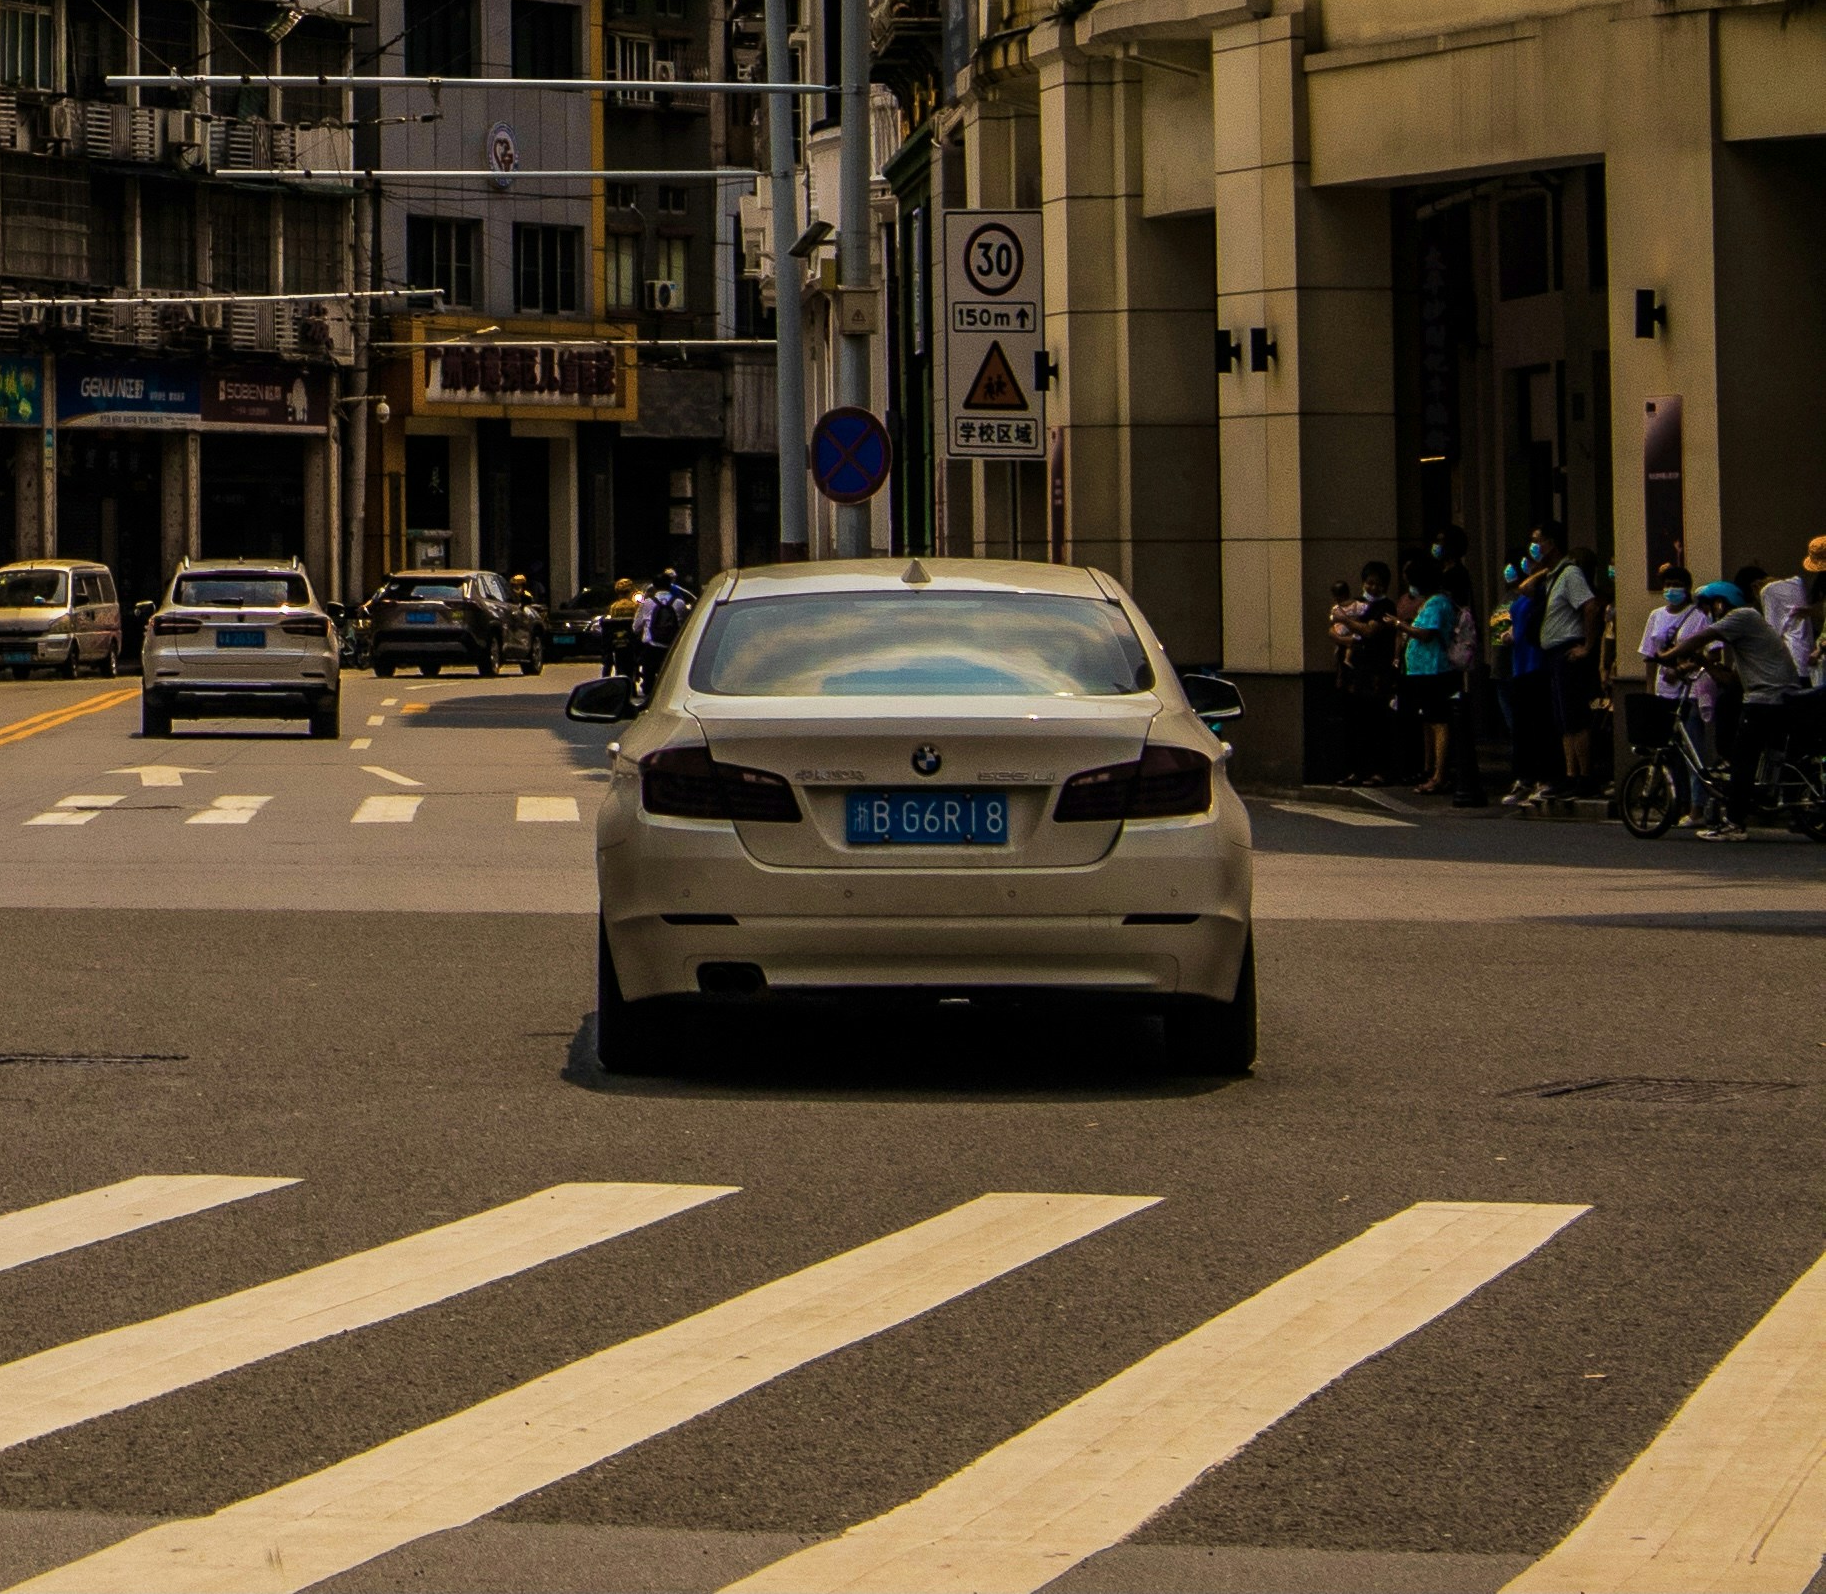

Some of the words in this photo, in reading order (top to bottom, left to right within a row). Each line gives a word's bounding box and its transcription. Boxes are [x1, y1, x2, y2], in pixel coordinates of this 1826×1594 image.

[975, 242, 1012, 276] 30
[957, 308, 1010, 326] 150m
[226, 382, 264, 400] SOBEN
[959, 422, 1033, 444] 学校区域
